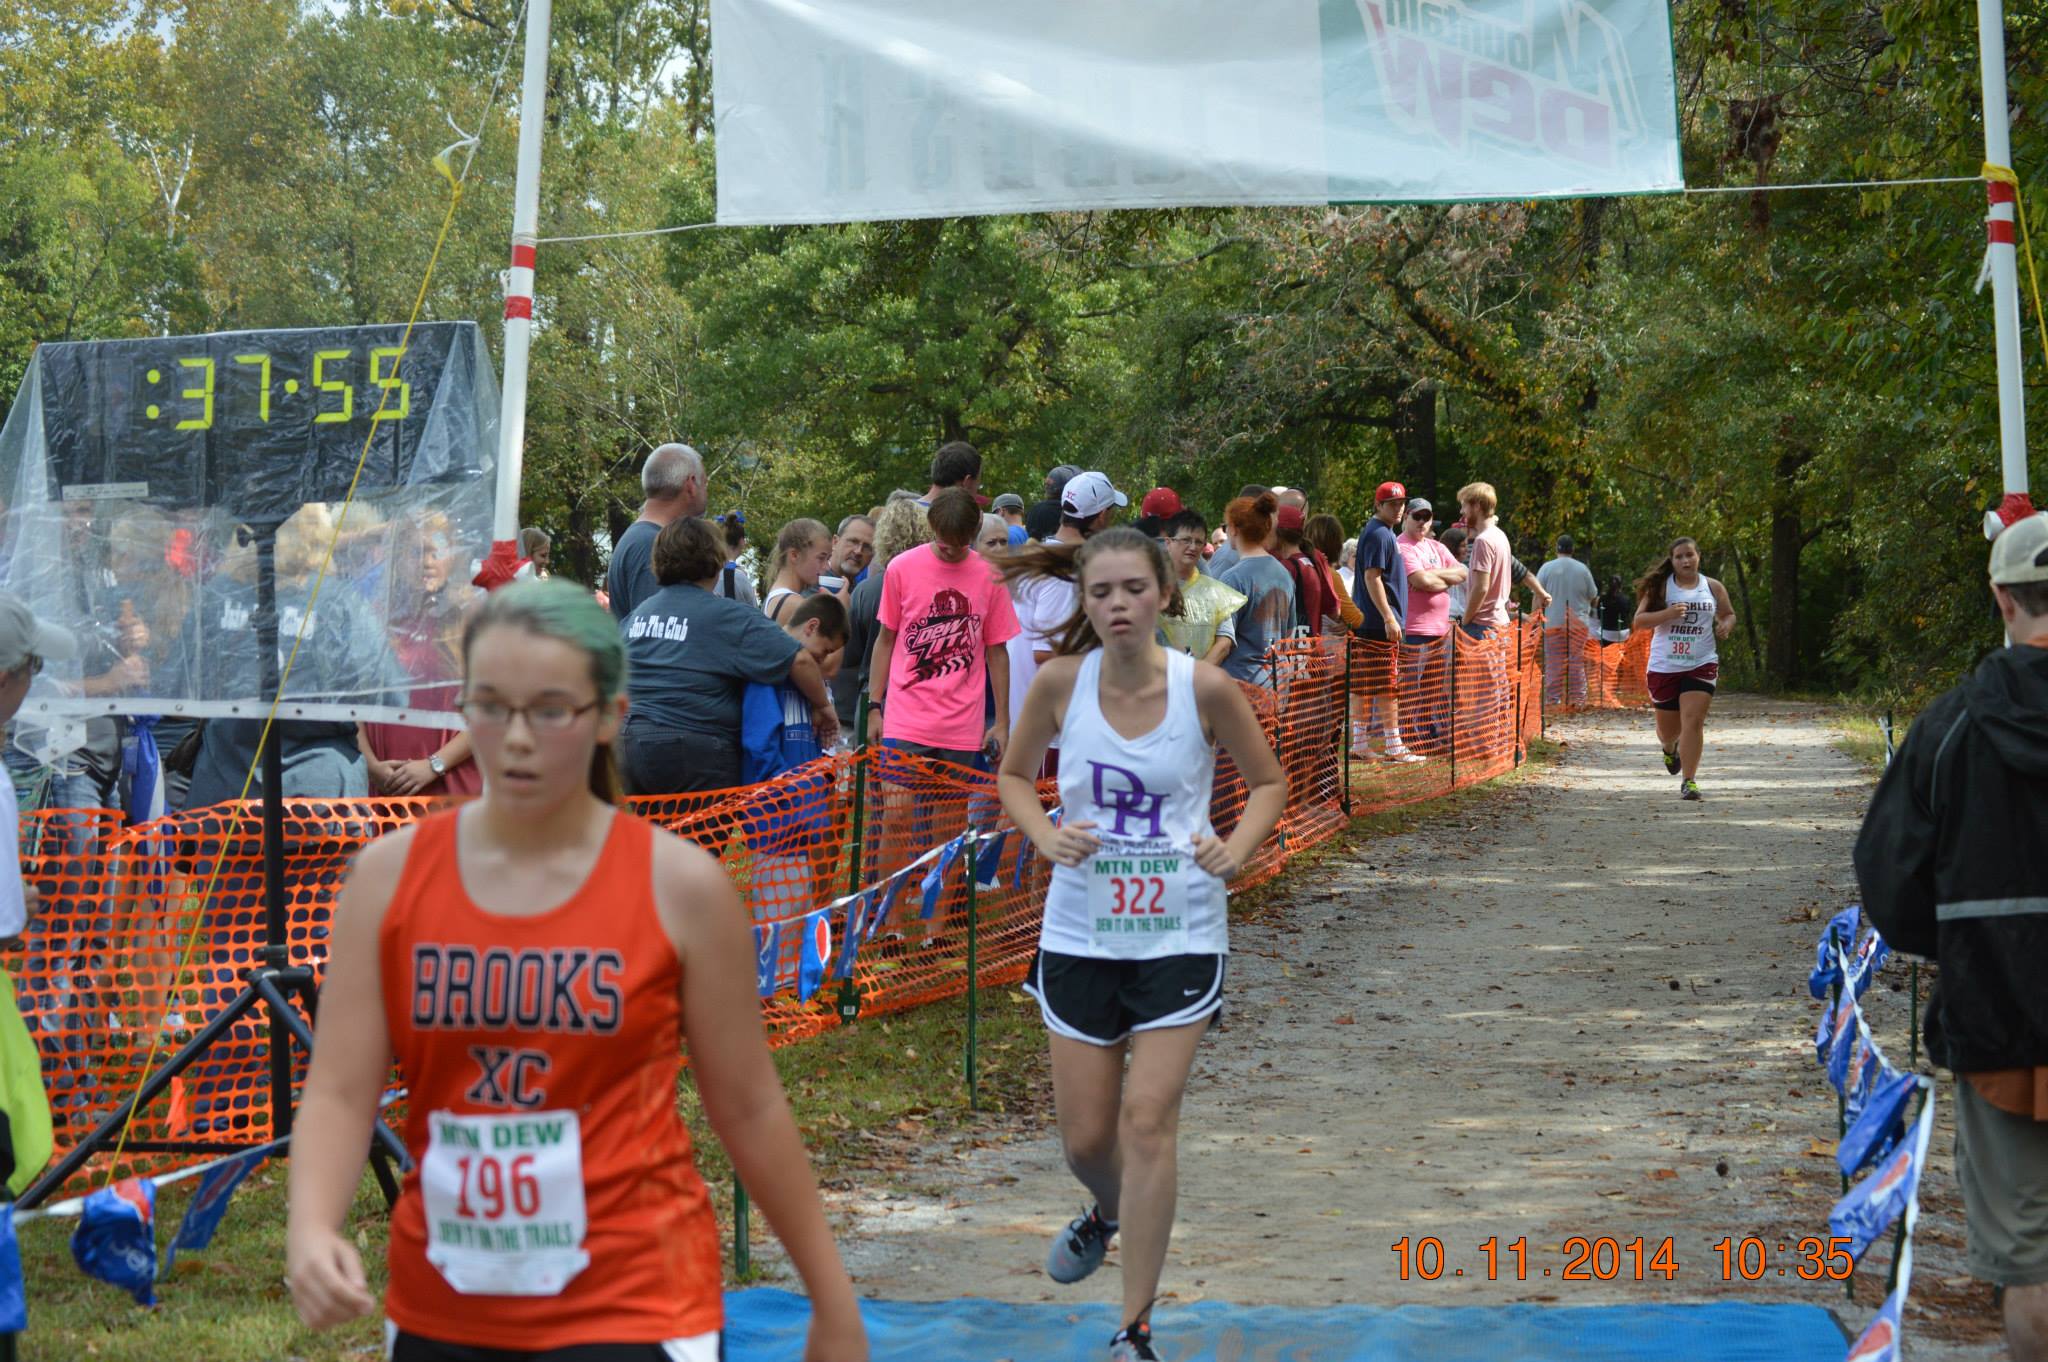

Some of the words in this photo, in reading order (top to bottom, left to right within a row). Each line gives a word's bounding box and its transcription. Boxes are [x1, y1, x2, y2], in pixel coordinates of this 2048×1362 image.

[645, 615, 665, 639] The
[664, 616, 689, 642] Club
[1670, 625, 1705, 635] TIGERS
[1672, 641, 1691, 654] 382
[1086, 760, 1171, 837] DH
[1095, 860, 1133, 875] MTN
[1140, 859, 1179, 874] DEW
[1109, 876, 1165, 914] 322
[1136, 917, 1151, 931] THE
[1153, 915, 1181, 930] TRAILS
[412, 943, 625, 1036] BROOKS
[465, 1045, 551, 1110] XC
[492, 1120, 563, 1148] DEW
[456, 1154, 541, 1219] 196
[525, 1222, 573, 1247] TRAILS
